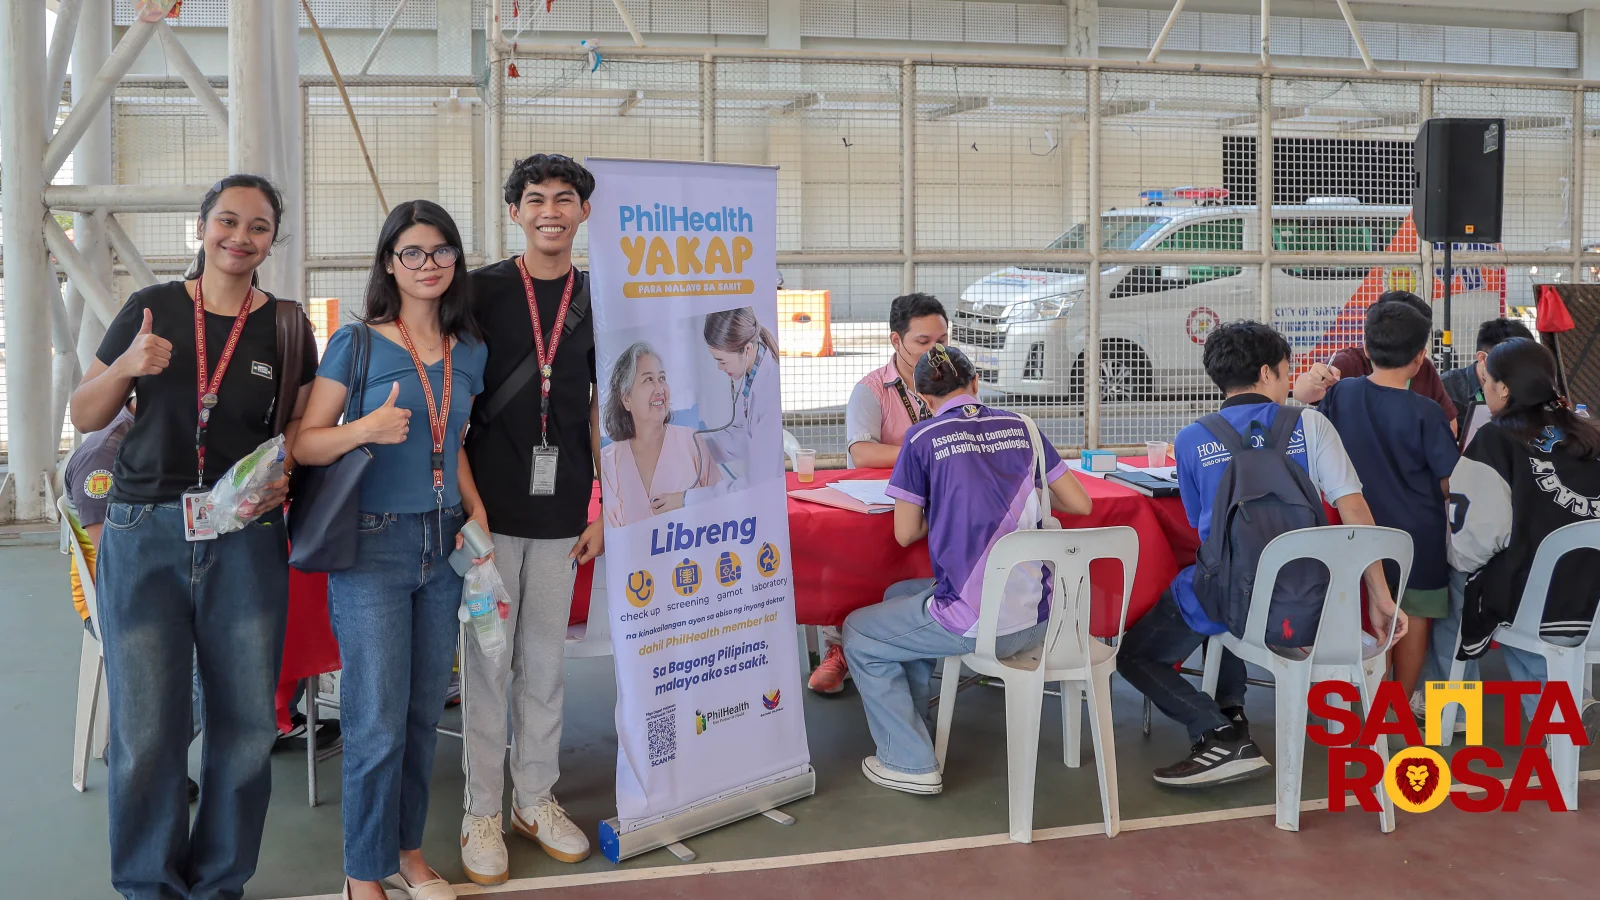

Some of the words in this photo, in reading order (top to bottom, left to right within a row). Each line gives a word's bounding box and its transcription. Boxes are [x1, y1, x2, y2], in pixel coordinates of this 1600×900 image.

[620, 203, 753, 232] PhilHealth
[620, 236, 754, 276] YAKAP
[638, 284, 662, 294] PARA
[664, 283, 701, 292] MALAYO
[704, 283, 716, 292] SA
[718, 282, 742, 291] SAKIT
[932, 430, 975, 448] Association
[985, 427, 1025, 441] Competent
[934, 446, 950, 461] and
[951, 443, 981, 454] Aspiring
[981, 438, 1030, 453] Psychologists
[1197, 442, 1227, 458] HOM
[650, 516, 757, 557] Libreng
[717, 588, 743, 602] gamot
[752, 577, 788, 592] laboratory
[666, 596, 709, 611] screening
[620, 609, 648, 622] check
[650, 607, 660, 616] up
[638, 620, 686, 638] kinakailangan
[688, 617, 705, 626] ayon
[716, 609, 732, 618] abiso
[744, 601, 765, 612] inyong
[766, 596, 785, 606] doktor
[639, 640, 664, 656] dahil
[666, 626, 720, 648] PhilHealth
[722, 618, 762, 634] member
[764, 611, 778, 623] ka!
[653, 666, 666, 678] Sa
[668, 653, 716, 673] Bagong
[718, 640, 769, 661] Pilipinas,
[655, 674, 700, 696] malayo
[701, 668, 722, 682] ako
[724, 664, 737, 675] sa
[738, 654, 769, 671] sakit.
[707, 701, 750, 721] PhilHealth
[651, 757, 668, 767] SCAN
[667, 753, 676, 762] ME
